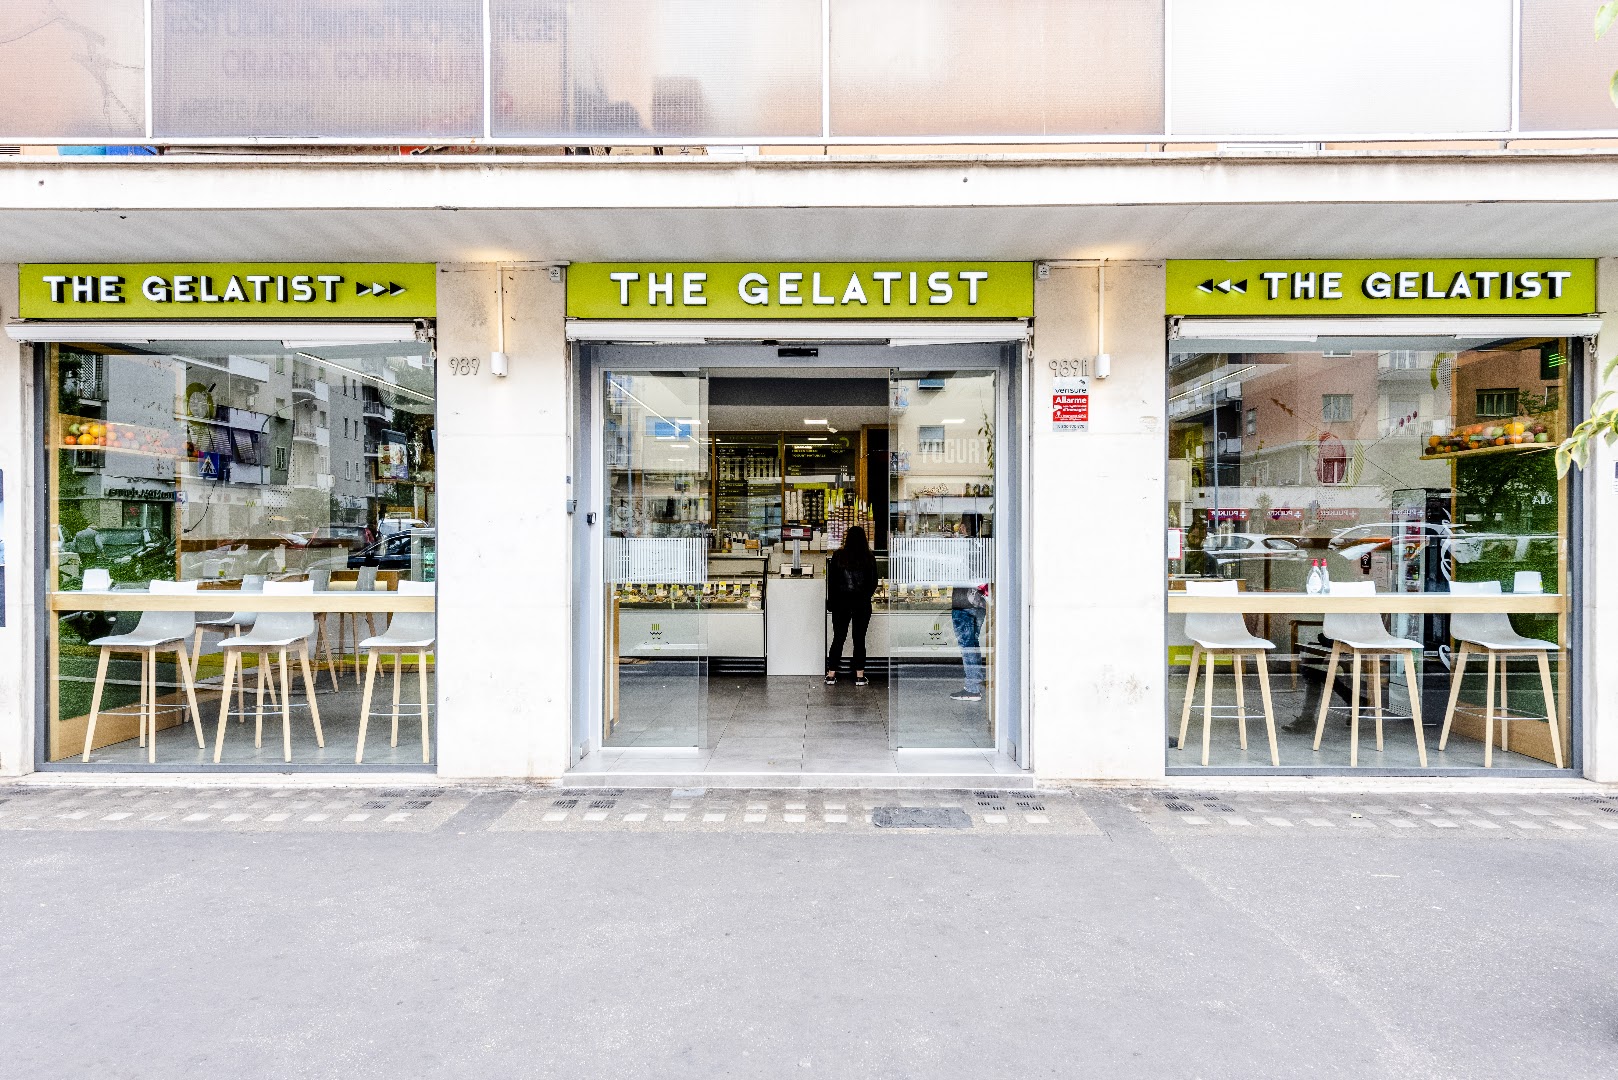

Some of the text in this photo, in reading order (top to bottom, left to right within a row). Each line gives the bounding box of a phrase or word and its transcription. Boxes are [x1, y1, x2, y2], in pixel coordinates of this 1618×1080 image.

[43, 275, 344, 303] THE GELATIST
[610, 272, 988, 306] THE GELATIST
[1260, 271, 1571, 300] THE GELATIST
[448, 357, 481, 376] 989
[1055, 395, 1087, 404] Allarme
